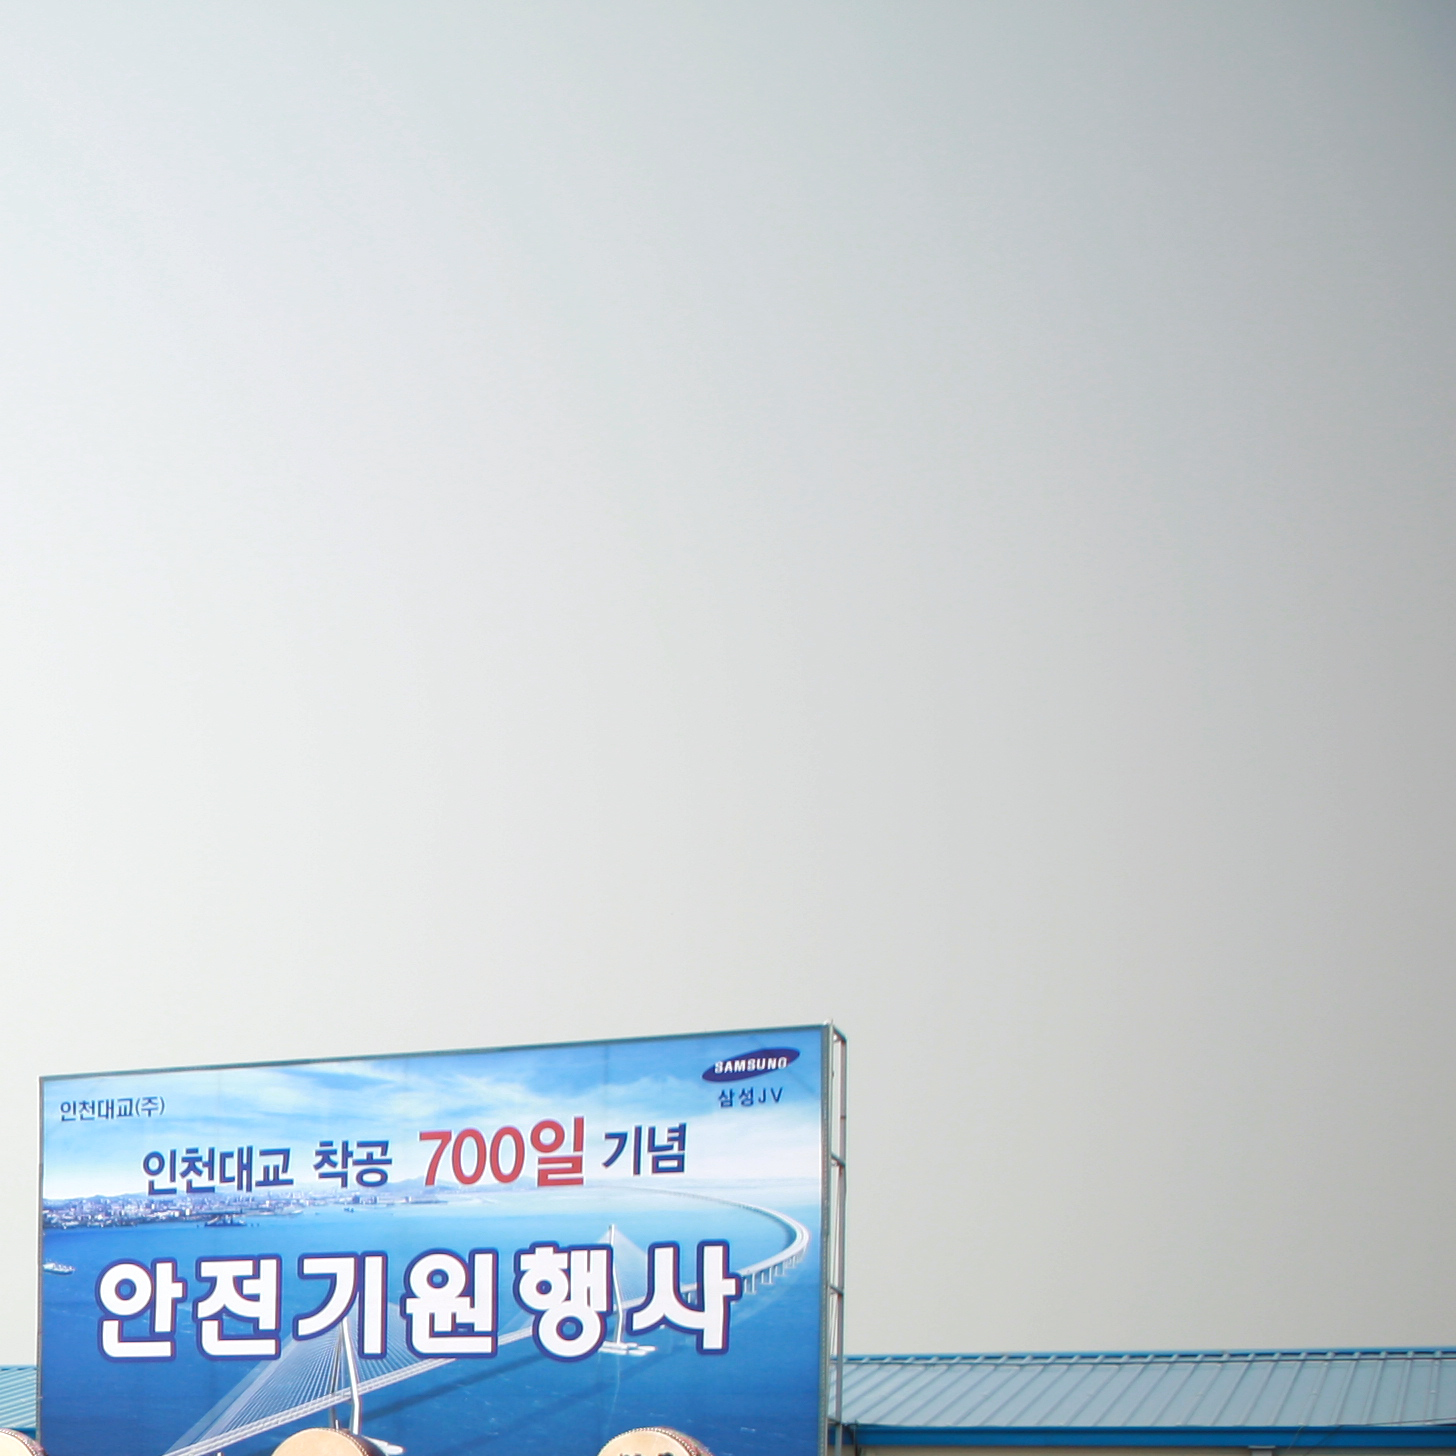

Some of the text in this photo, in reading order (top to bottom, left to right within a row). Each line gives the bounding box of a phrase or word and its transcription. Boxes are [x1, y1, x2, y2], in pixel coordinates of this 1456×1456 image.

[714, 1056, 788, 1074] SAMSUNG
[59, 1096, 166, 1122] 인천대교(주)
[717, 1086, 784, 1109] 삼성JV
[142, 1115, 688, 1197] 인천대교 착공 700일 기념
[95, 1240, 740, 1362] 안전기원행사
